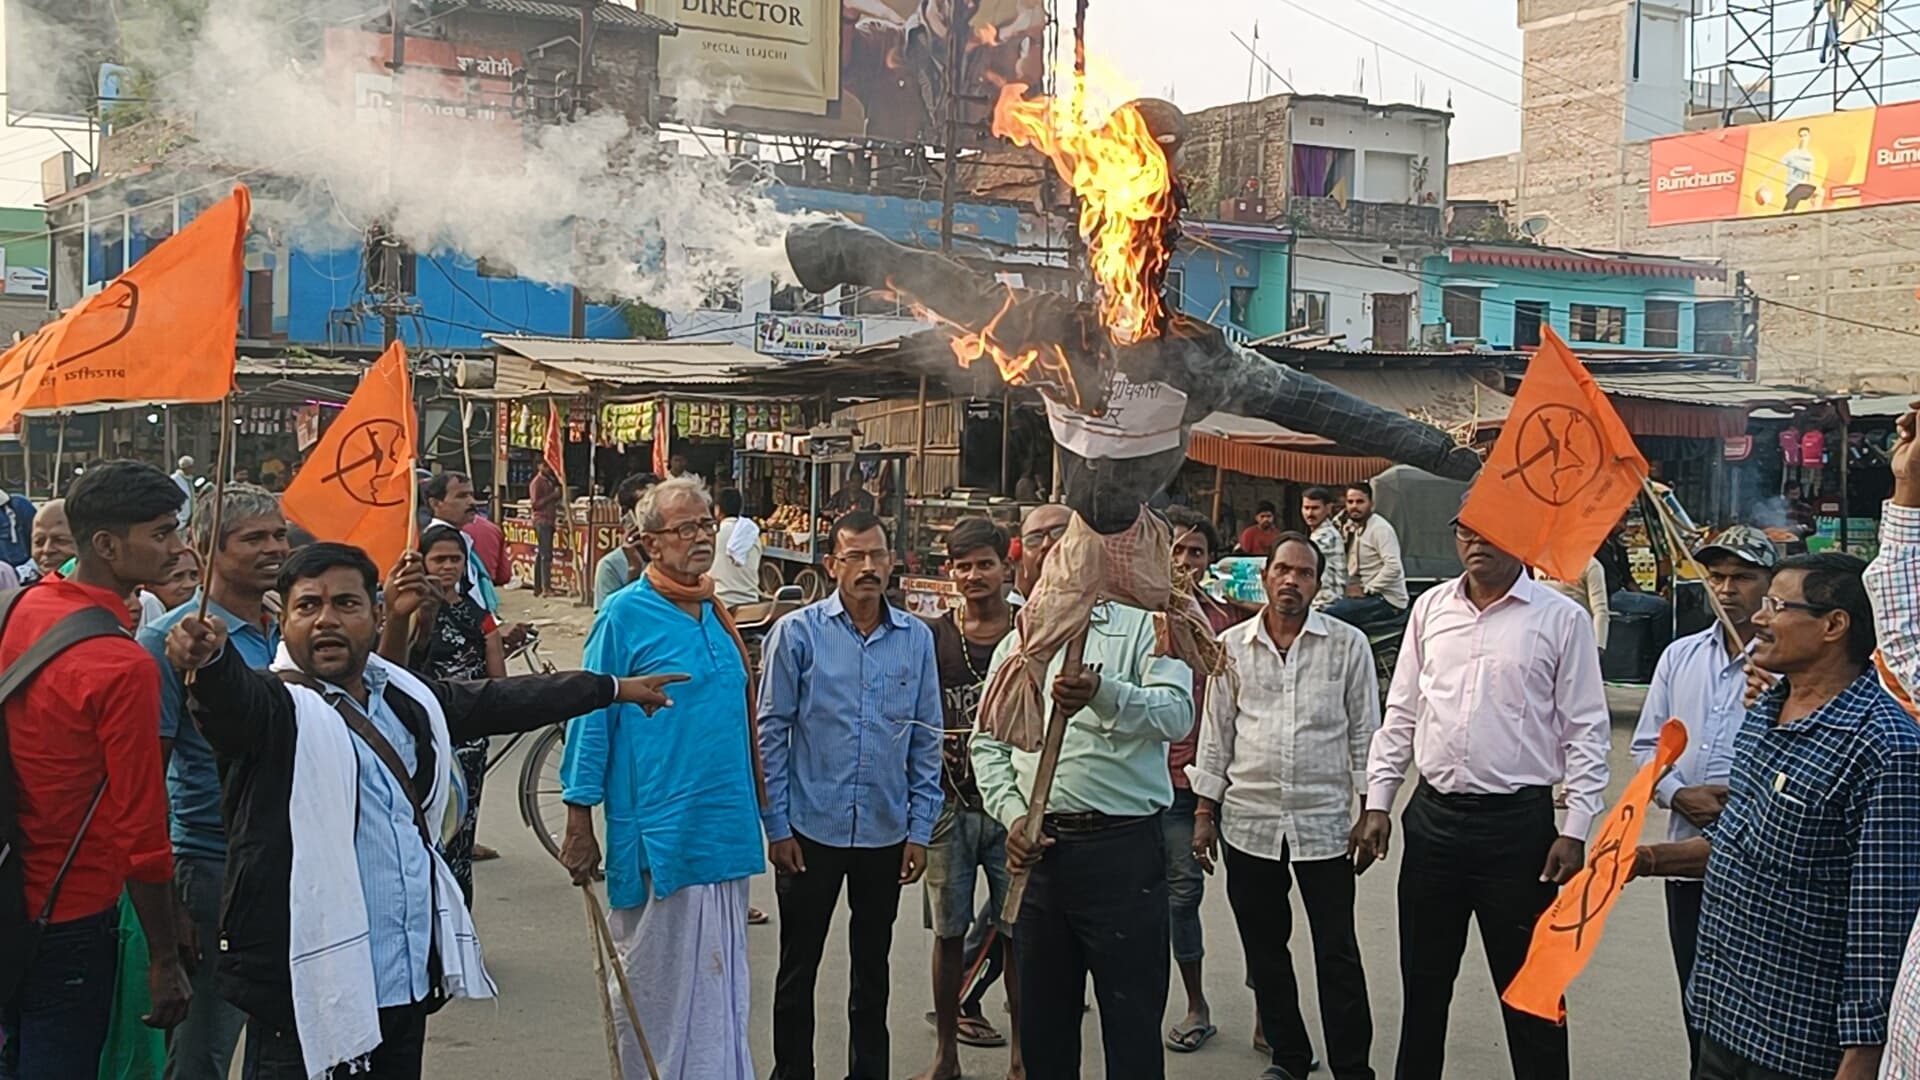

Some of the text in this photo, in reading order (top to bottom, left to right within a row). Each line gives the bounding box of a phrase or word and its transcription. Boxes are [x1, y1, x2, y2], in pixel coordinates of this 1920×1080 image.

[682, 0, 804, 26] DIRECTOR
[701, 41, 740, 54] SPECIAL
[1656, 170, 1737, 191] Bumchums
